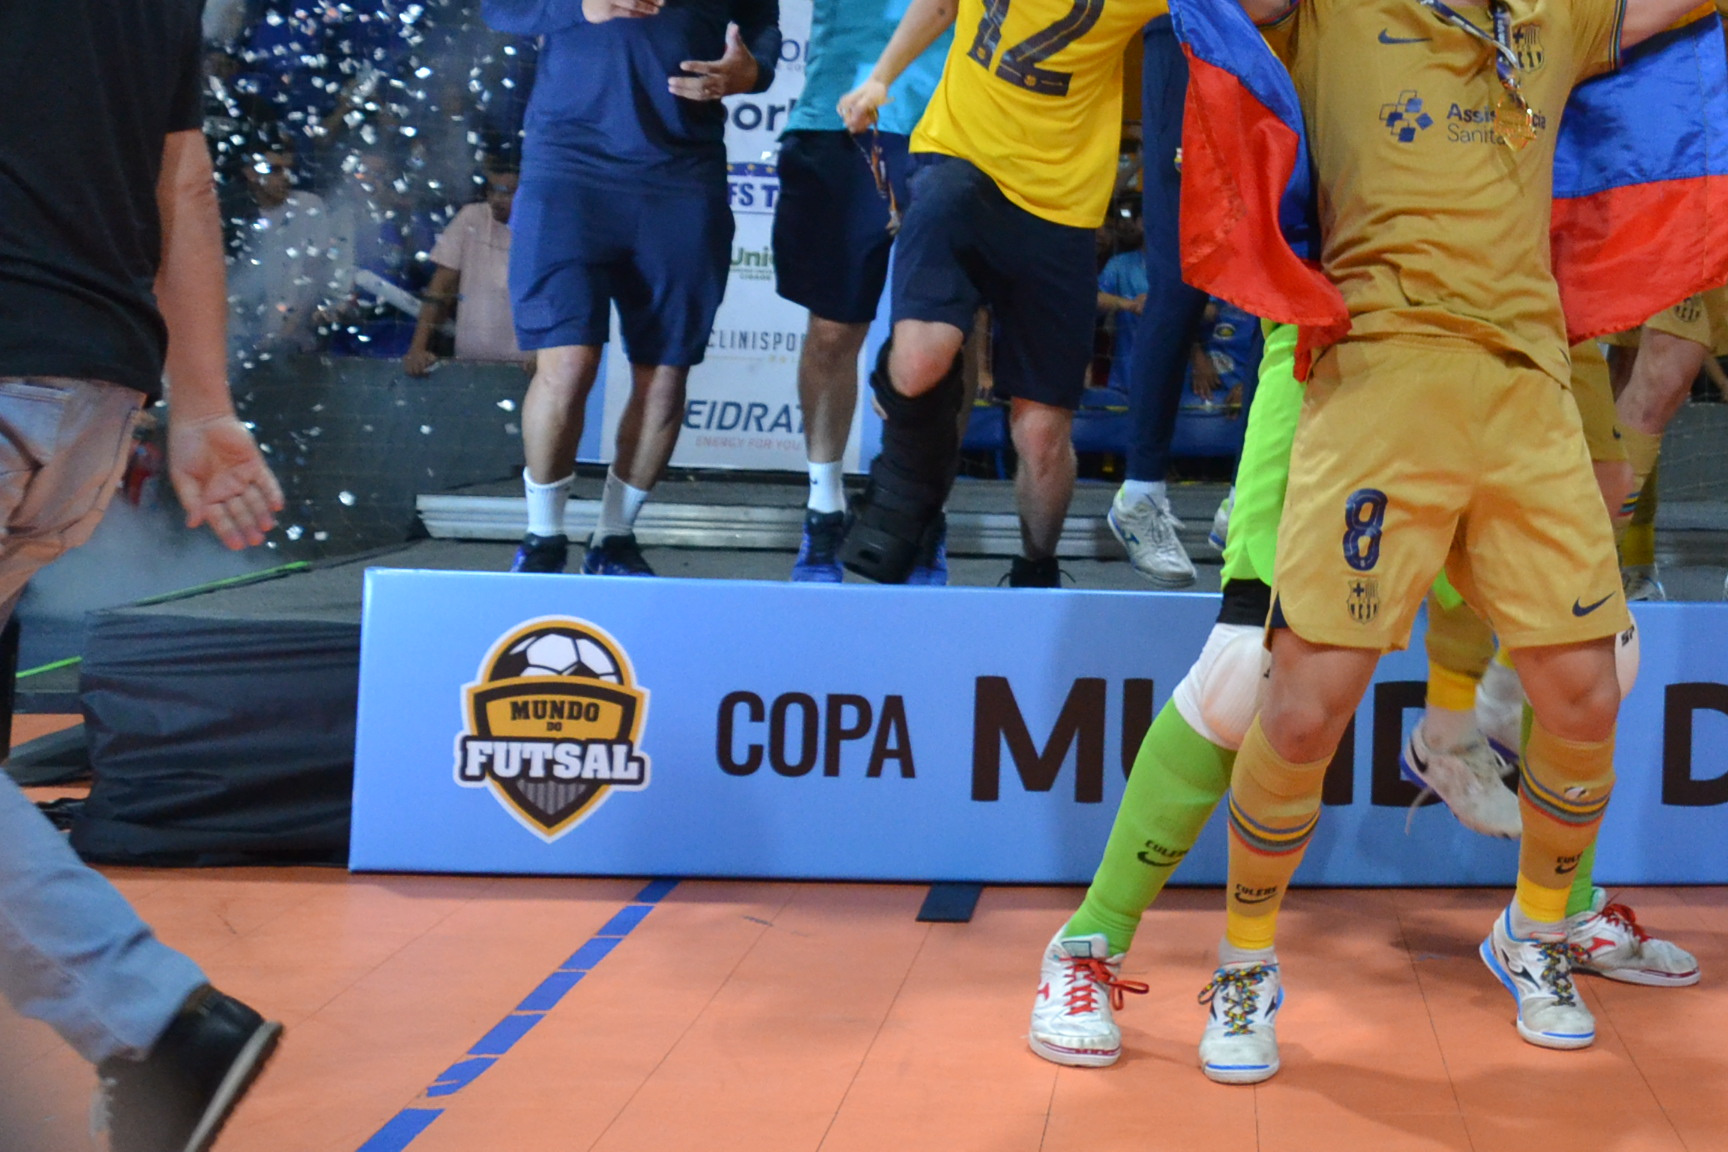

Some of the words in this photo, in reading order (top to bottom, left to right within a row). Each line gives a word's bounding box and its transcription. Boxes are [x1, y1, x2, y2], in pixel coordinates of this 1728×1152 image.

[1342, 487, 1388, 571] 8
[510, 700, 600, 722] MUNDO
[546, 722, 562, 732] DO
[717, 690, 916, 779] COPA
[464, 740, 641, 780] FUTSAL
